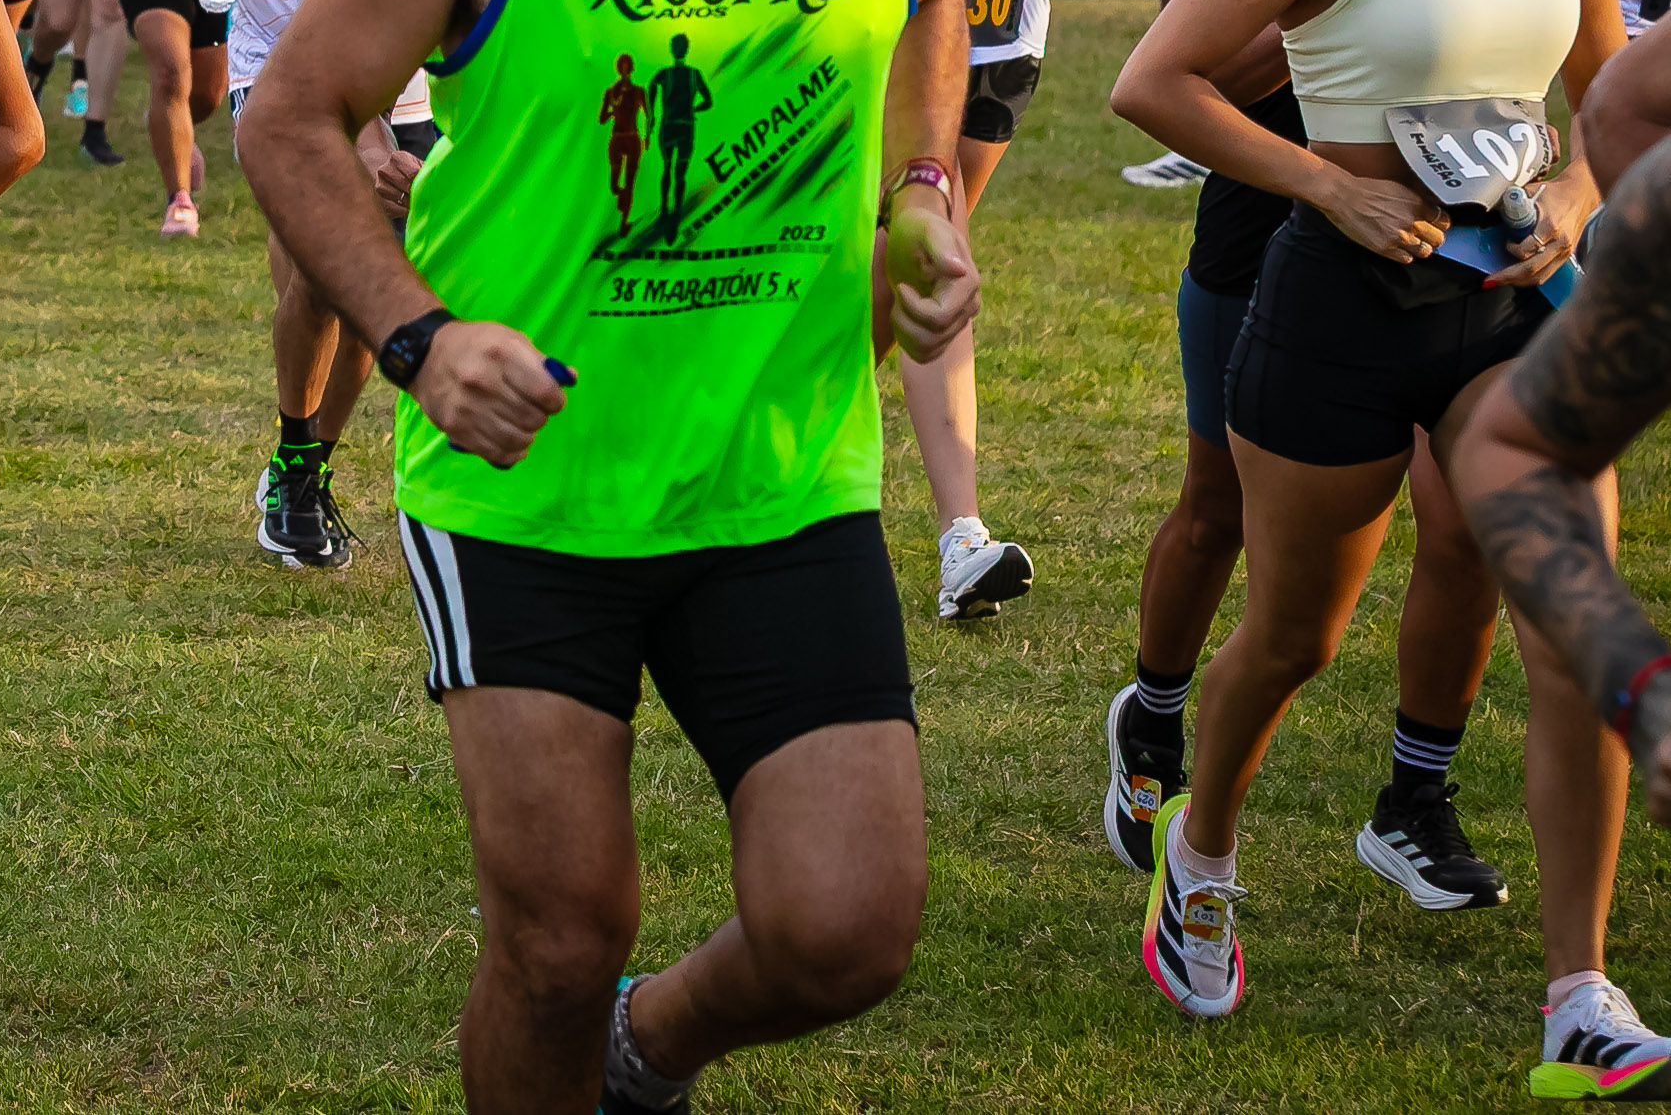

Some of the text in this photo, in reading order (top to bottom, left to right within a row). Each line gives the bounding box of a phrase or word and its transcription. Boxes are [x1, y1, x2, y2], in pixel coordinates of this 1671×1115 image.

[706, 55, 840, 183] EMPALME
[1436, 123, 1537, 187] 102
[778, 225, 827, 241] 2023
[609, 268, 801, 307] 38 MARATÓN 5 K
